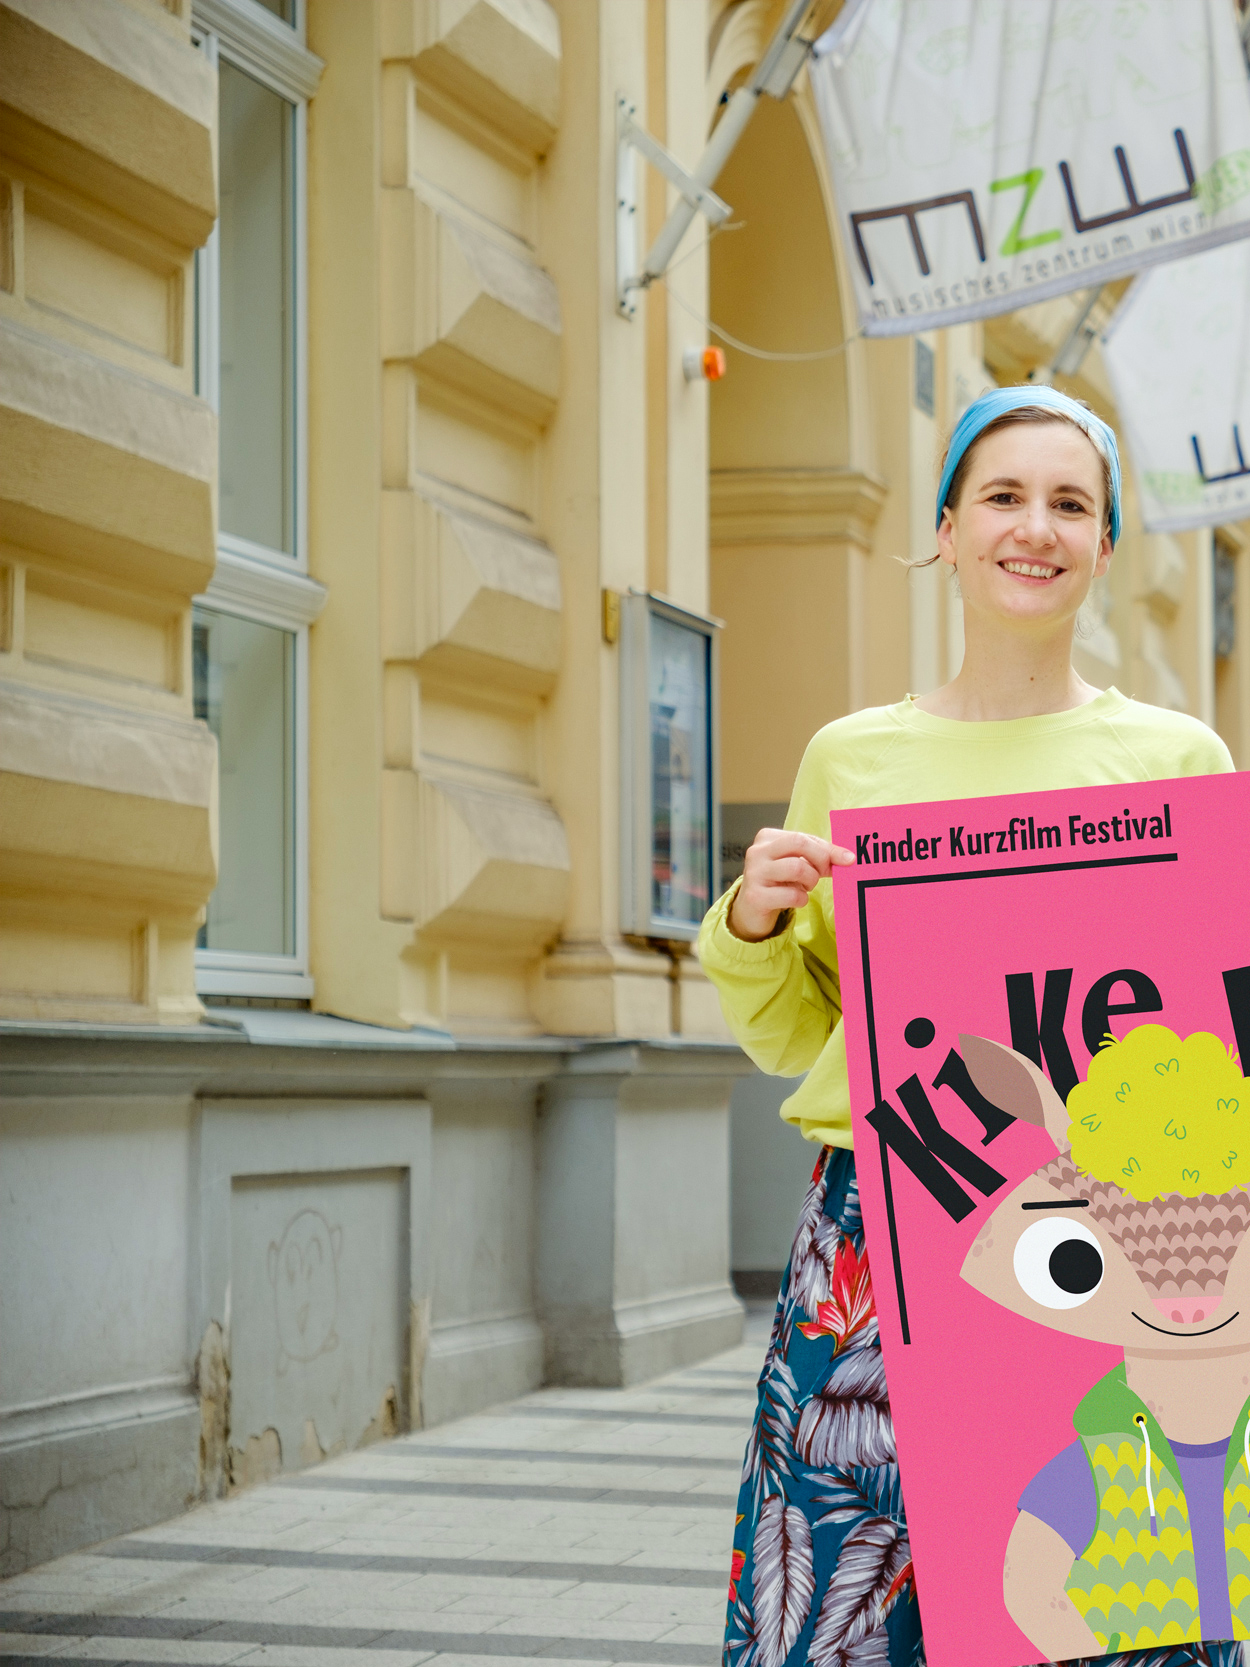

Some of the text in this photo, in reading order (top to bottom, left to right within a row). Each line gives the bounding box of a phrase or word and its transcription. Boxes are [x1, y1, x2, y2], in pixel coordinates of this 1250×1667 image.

[871, 212, 1210, 317] musisches zentrum wien
[856, 803, 1172, 865] Kinder Kurzfilm Festival
